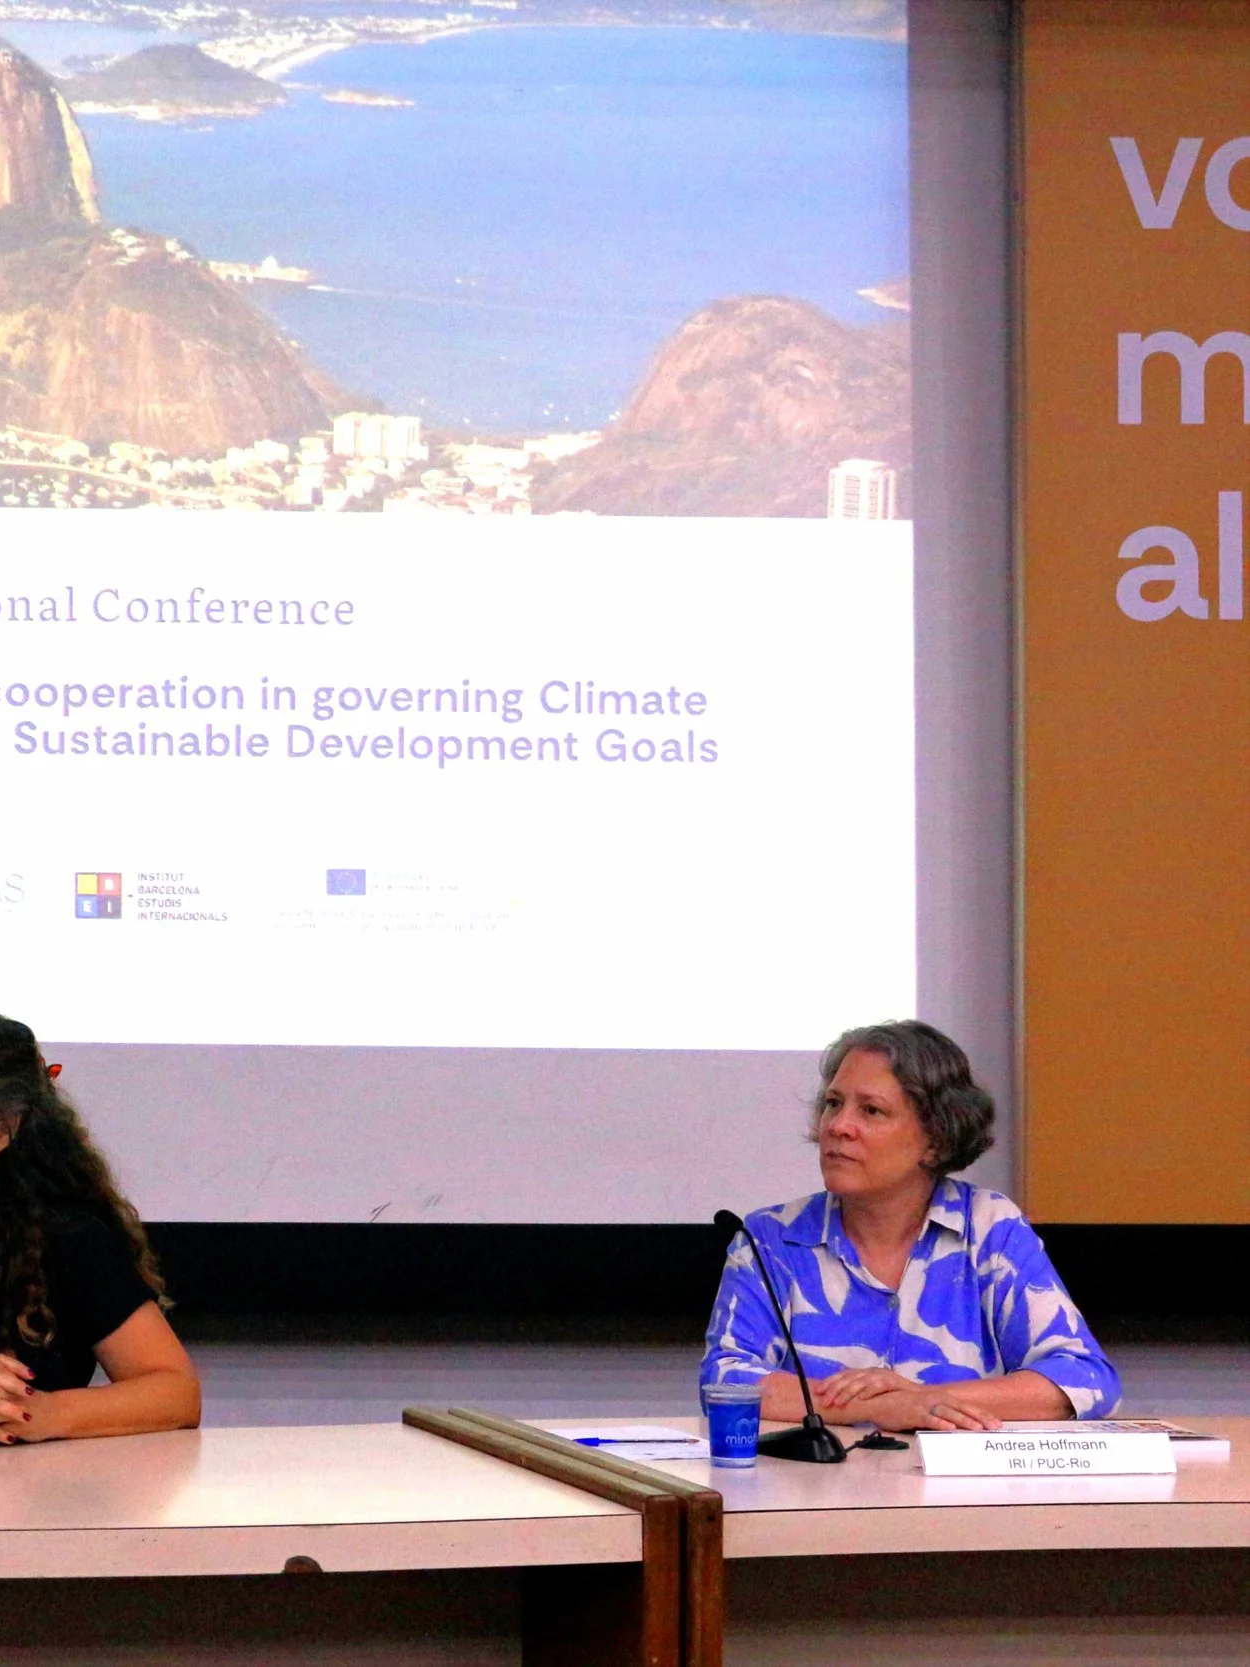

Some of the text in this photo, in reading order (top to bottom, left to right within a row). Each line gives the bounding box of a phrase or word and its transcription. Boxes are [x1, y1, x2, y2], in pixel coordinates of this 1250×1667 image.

[1115, 491, 1243, 621] al
[92, 586, 355, 625] Conference
[260, 676, 297, 712] in
[312, 678, 524, 722] governing
[539, 680, 708, 717] Climate
[13, 721, 270, 759] Sustainable
[286, 725, 579, 770] Development
[594, 728, 719, 764] Goals
[137, 885, 200, 895] BARCELONA
[984, 1438, 1107, 1451] Andrea Hoffmann
[1008, 1458, 1026, 1469] IRI
[1036, 1458, 1091, 1470] PUC-Rio
